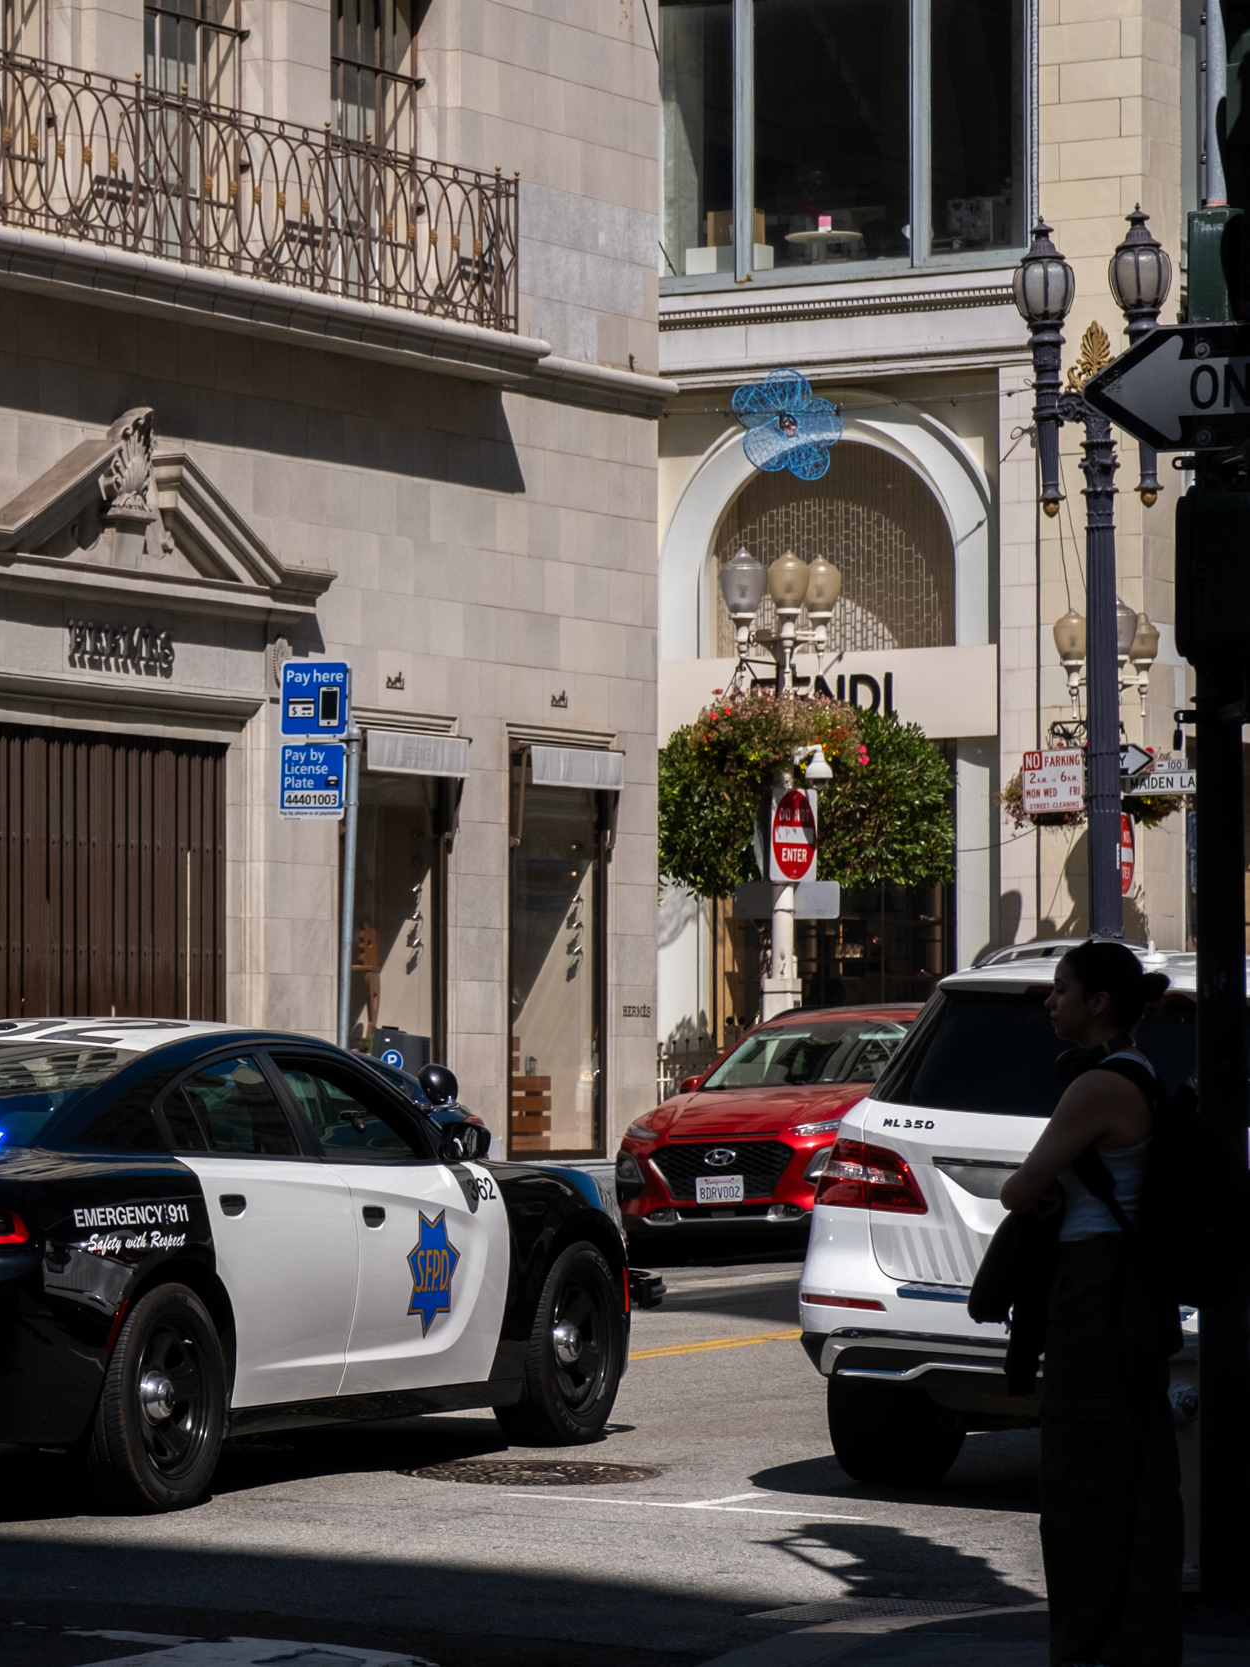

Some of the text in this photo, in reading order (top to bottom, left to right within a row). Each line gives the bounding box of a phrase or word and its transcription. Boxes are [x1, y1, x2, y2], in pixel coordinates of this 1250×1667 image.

[1190, 364, 1250, 409] ON
[286, 669, 344, 686] Pay here
[284, 749, 325, 763] Pay by
[1025, 753, 1080, 769] NO PARKING
[284, 762, 328, 774] License
[1168, 761, 1182, 770] 100
[284, 776, 314, 788] Plate
[1130, 776, 1174, 790] MAIDEN
[1026, 786, 1080, 798] MON WED FRI
[285, 794, 337, 805] 44401003
[1053, 801, 1079, 809] CLEANING
[779, 808, 810, 822] DO NOT
[781, 848, 808, 863] ENTER
[883, 1118, 935, 1129] ML 350
[467, 1177, 497, 1201] 362
[699, 1185, 741, 1200] 8DRV002
[73, 1205, 163, 1228] EMERGENCY
[168, 1204, 190, 1223] 911
[87, 1230, 186, 1256] Safety with Respect
